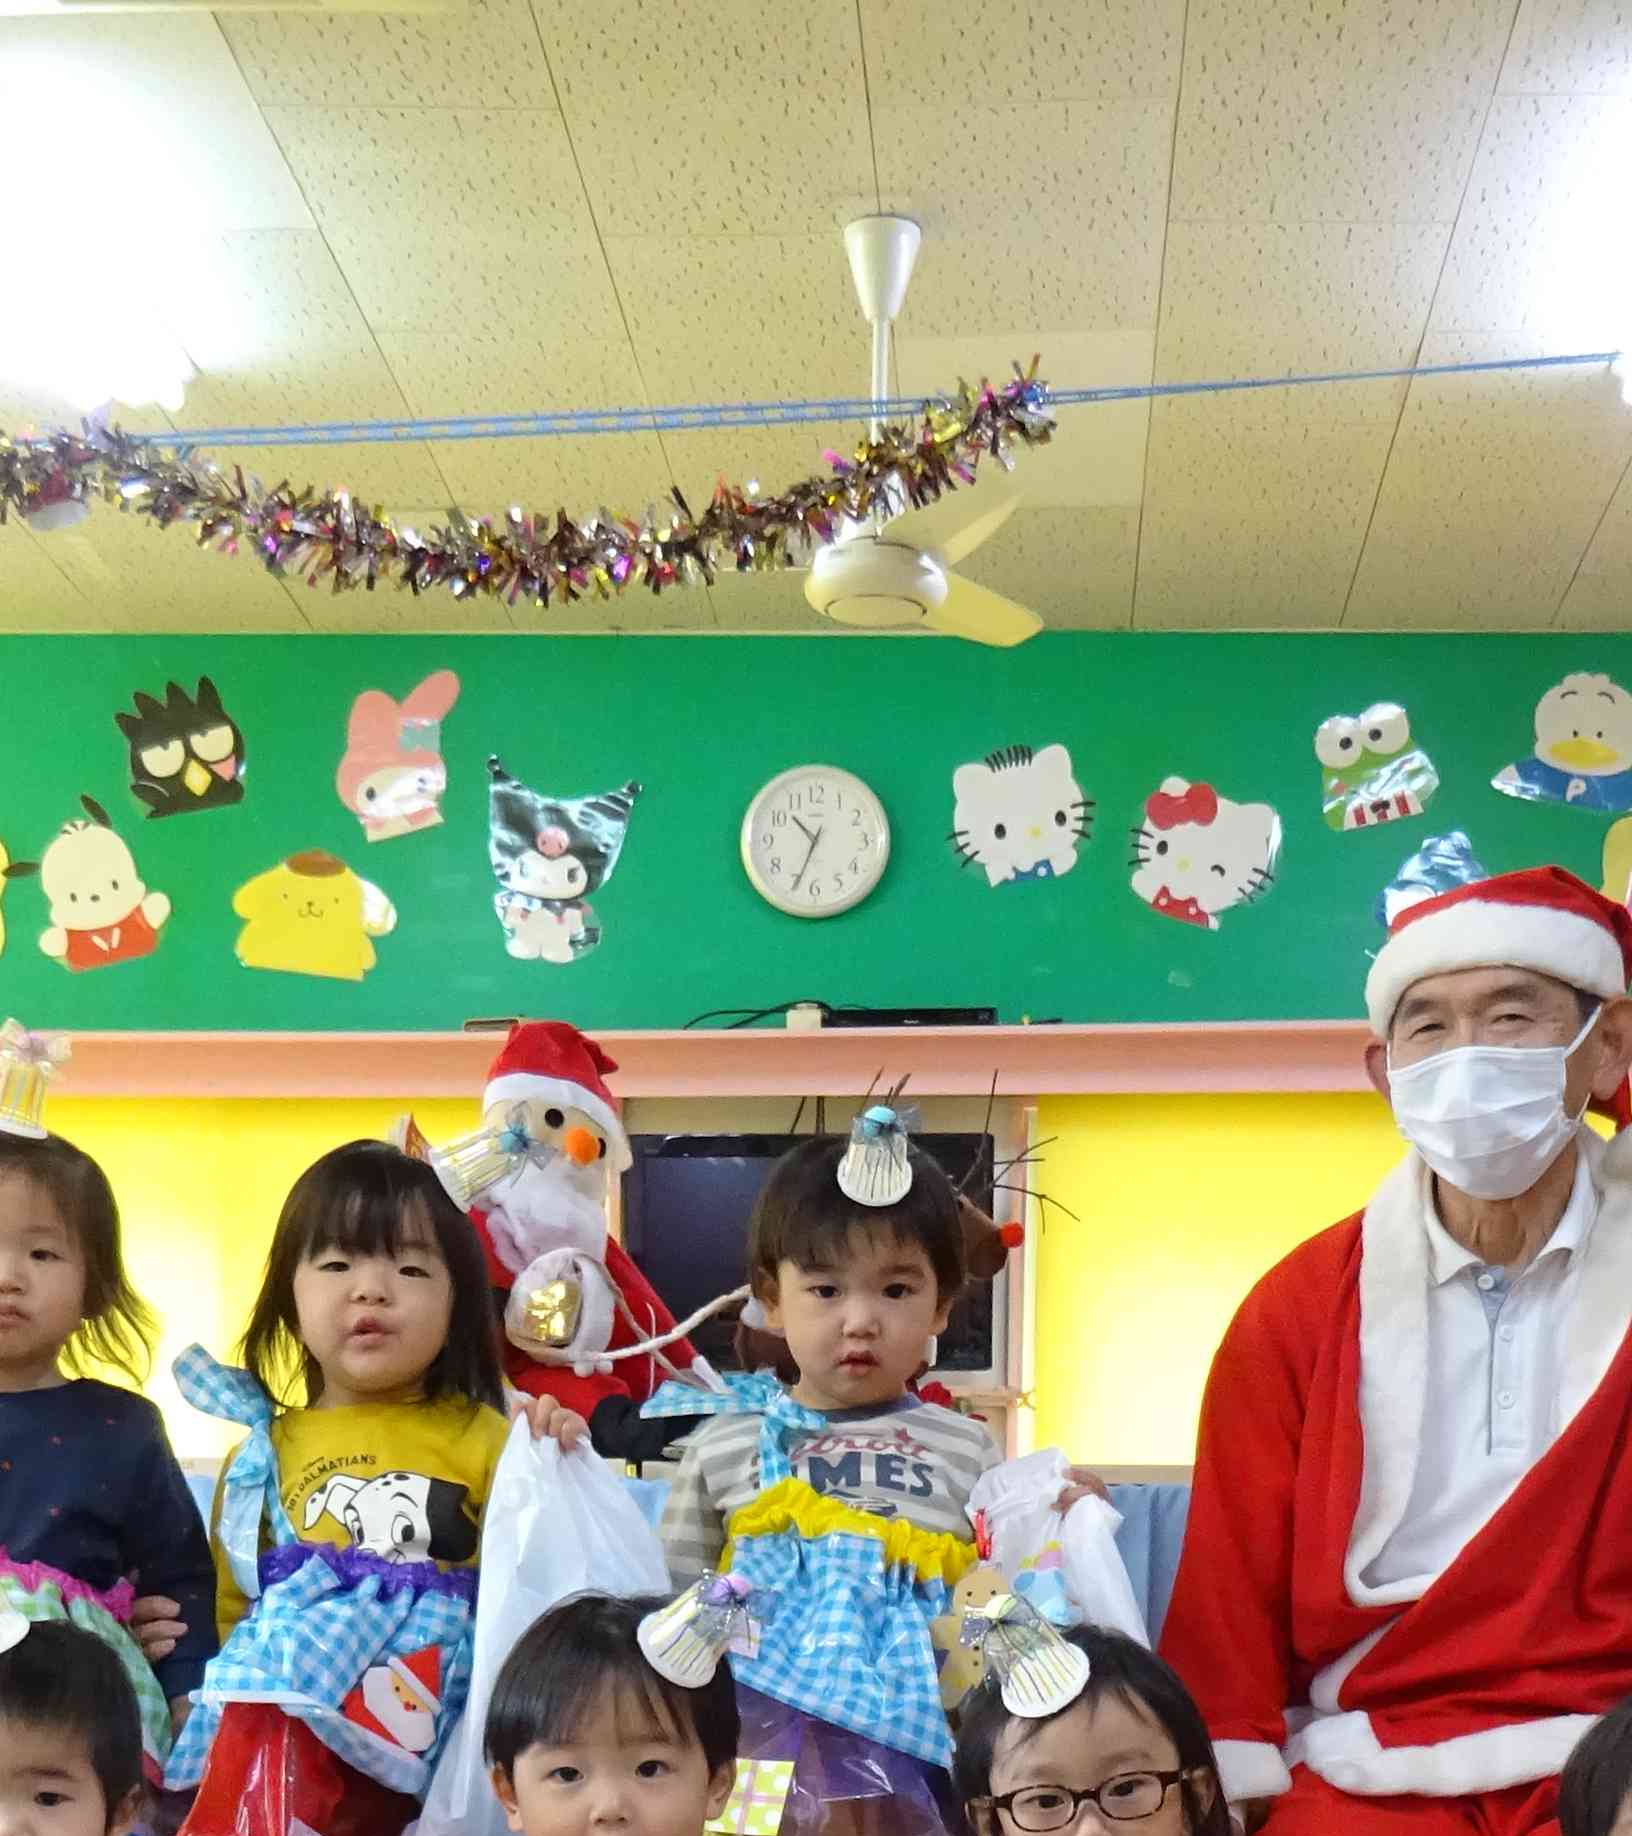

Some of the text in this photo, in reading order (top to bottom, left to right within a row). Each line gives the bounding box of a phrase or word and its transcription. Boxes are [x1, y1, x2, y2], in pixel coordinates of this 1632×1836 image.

[790, 793, 801, 809] 11
[808, 785, 824, 803] 12
[837, 792, 842, 809] 1
[772, 810, 786, 827] 10
[852, 809, 861, 826] 2
[763, 834, 774, 848] 9
[860, 832, 869, 851] 3
[770, 856, 781, 874] 8
[848, 858, 857, 874] 4
[809, 879, 820, 896] 6
[834, 874, 843, 890] 5
[299, 1454, 376, 1491] DALMATIANS
